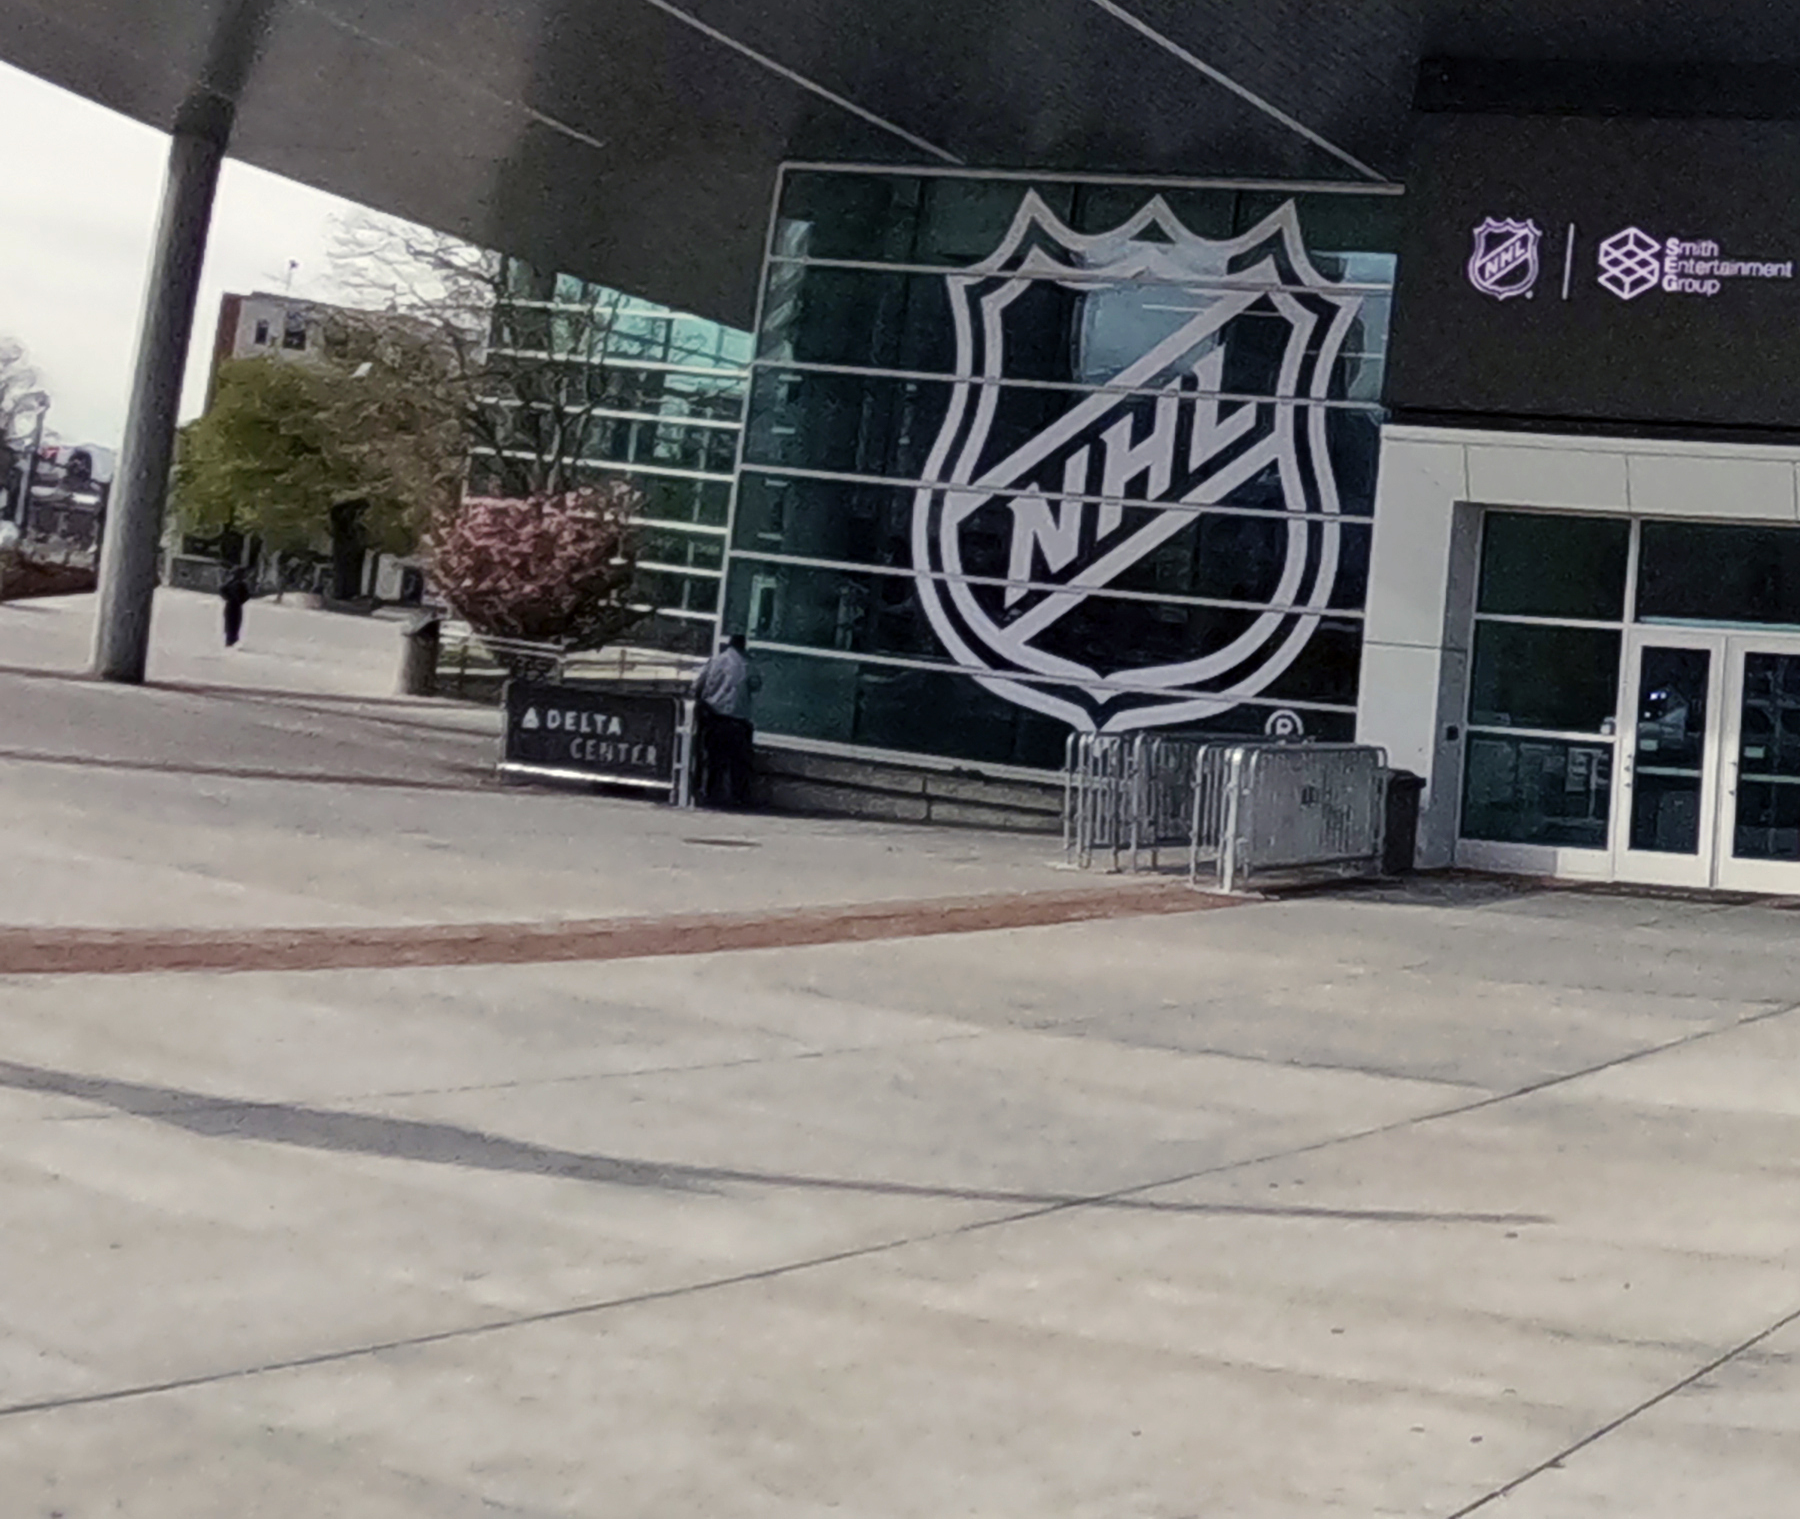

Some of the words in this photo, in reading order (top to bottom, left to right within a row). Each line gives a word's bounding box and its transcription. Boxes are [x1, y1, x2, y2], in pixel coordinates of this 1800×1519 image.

[1484, 240, 1526, 279] NHL
[1665, 237, 1719, 256] Smith
[1663, 256, 1793, 278] Entertainment
[1661, 275, 1721, 297] Group
[1003, 343, 1257, 609] NHL
[546, 708, 622, 736] DELTA
[569, 736, 658, 766] CENTER
